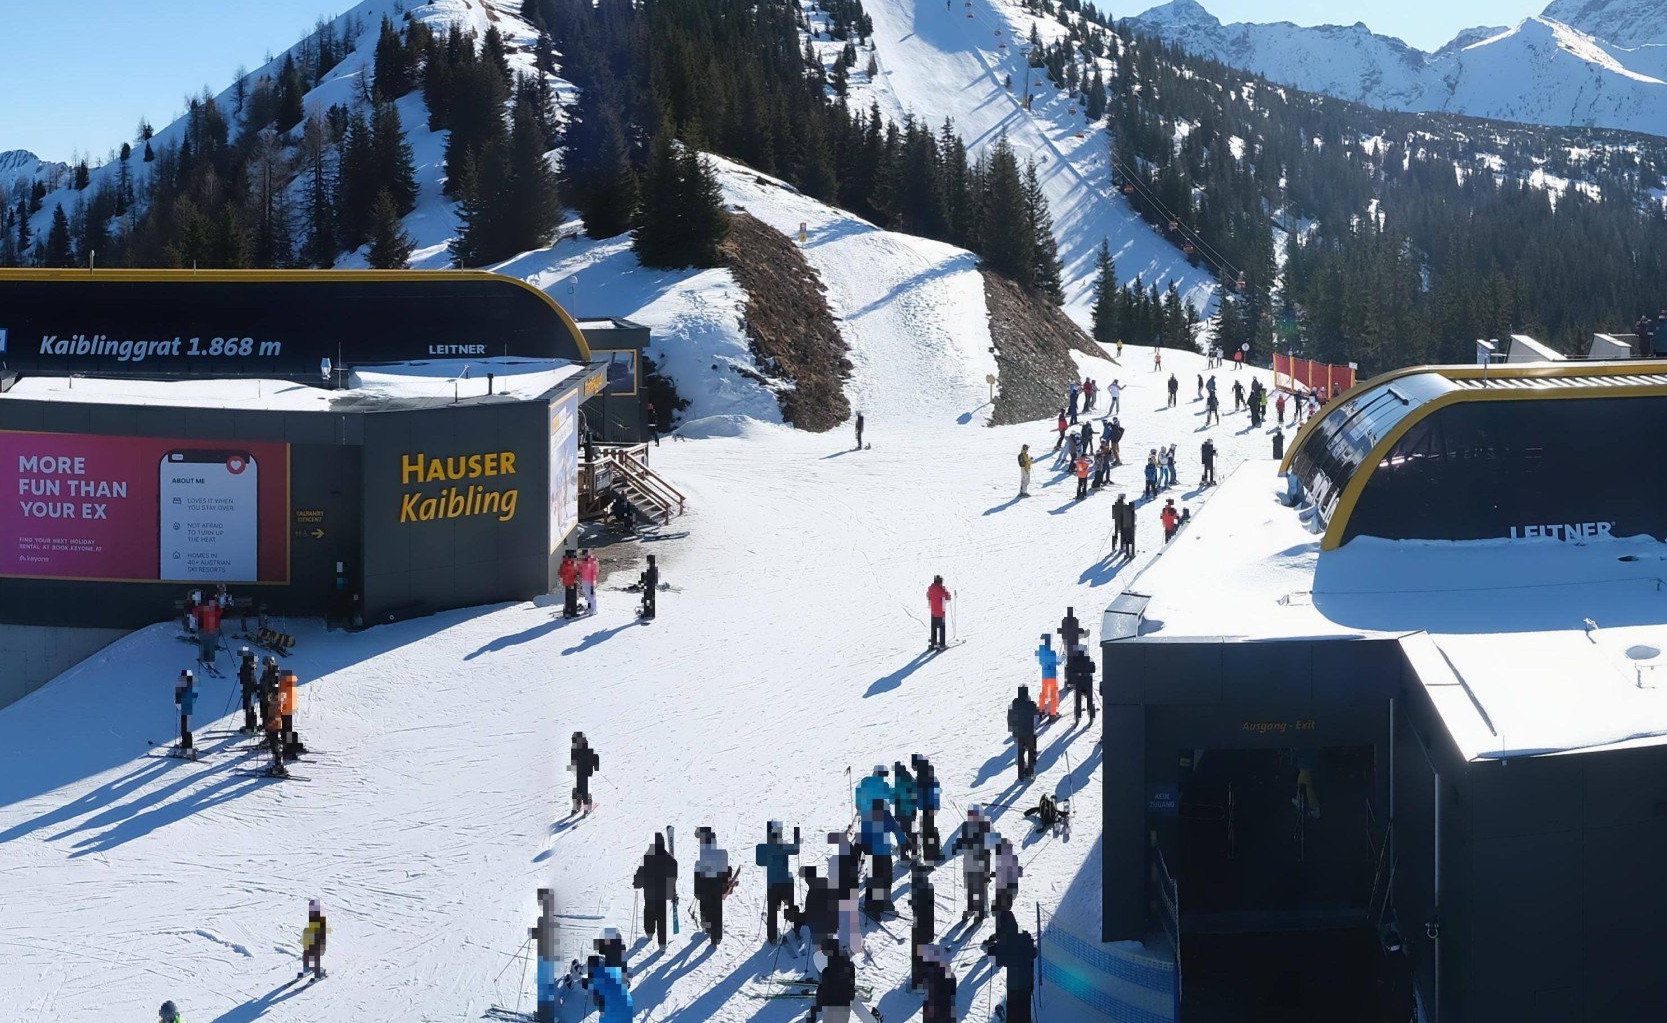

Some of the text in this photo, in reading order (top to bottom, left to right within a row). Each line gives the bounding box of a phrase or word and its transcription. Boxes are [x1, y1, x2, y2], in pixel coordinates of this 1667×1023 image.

[39, 335, 281, 361] Kaiblinggrat 1.868 m
[429, 345, 486, 354] LEITNER
[19, 455, 85, 475] MORE
[402, 451, 516, 485] HAUSER
[19, 479, 127, 498] FUN THAN
[20, 501, 107, 519] YOUR EX
[400, 485, 518, 523] Kaibling
[1242, 721, 1287, 733] Ausgang
[1296, 719, 1316, 729] Exit
